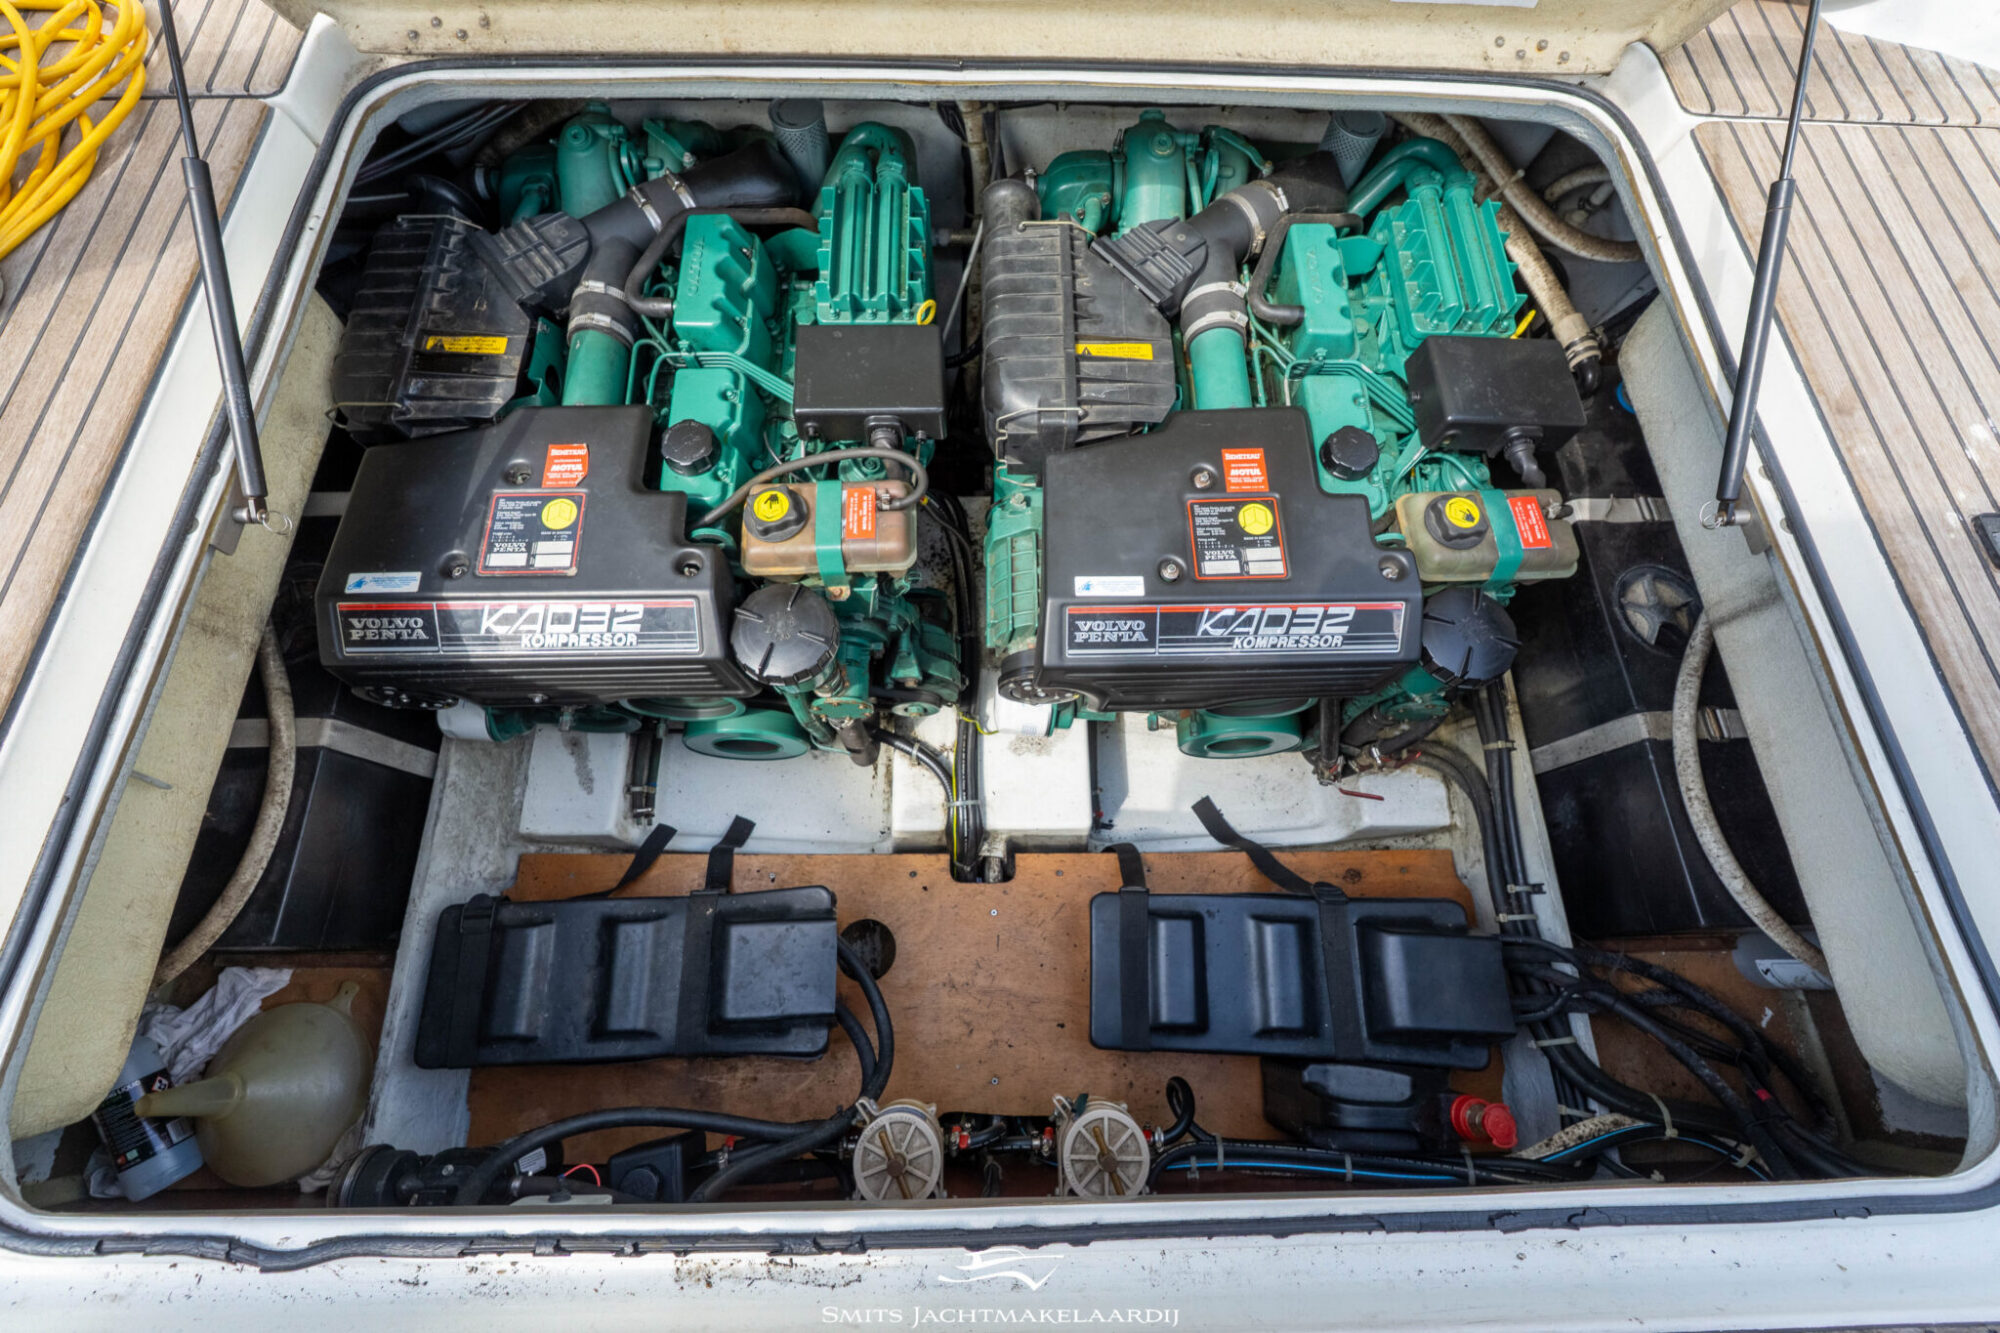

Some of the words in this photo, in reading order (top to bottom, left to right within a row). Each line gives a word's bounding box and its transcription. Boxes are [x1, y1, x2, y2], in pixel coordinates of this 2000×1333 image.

[349, 618, 424, 628] VOLVO
[480, 604, 644, 634] KAD32
[1074, 620, 1146, 631] VOLVO
[1198, 607, 1356, 636] KAD32
[349, 628, 429, 641] PENTA
[520, 632, 638, 648] KOMPRESSOR
[1074, 631, 1147, 643] PENTA
[1232, 635, 1343, 649] KOMPRESSOR
